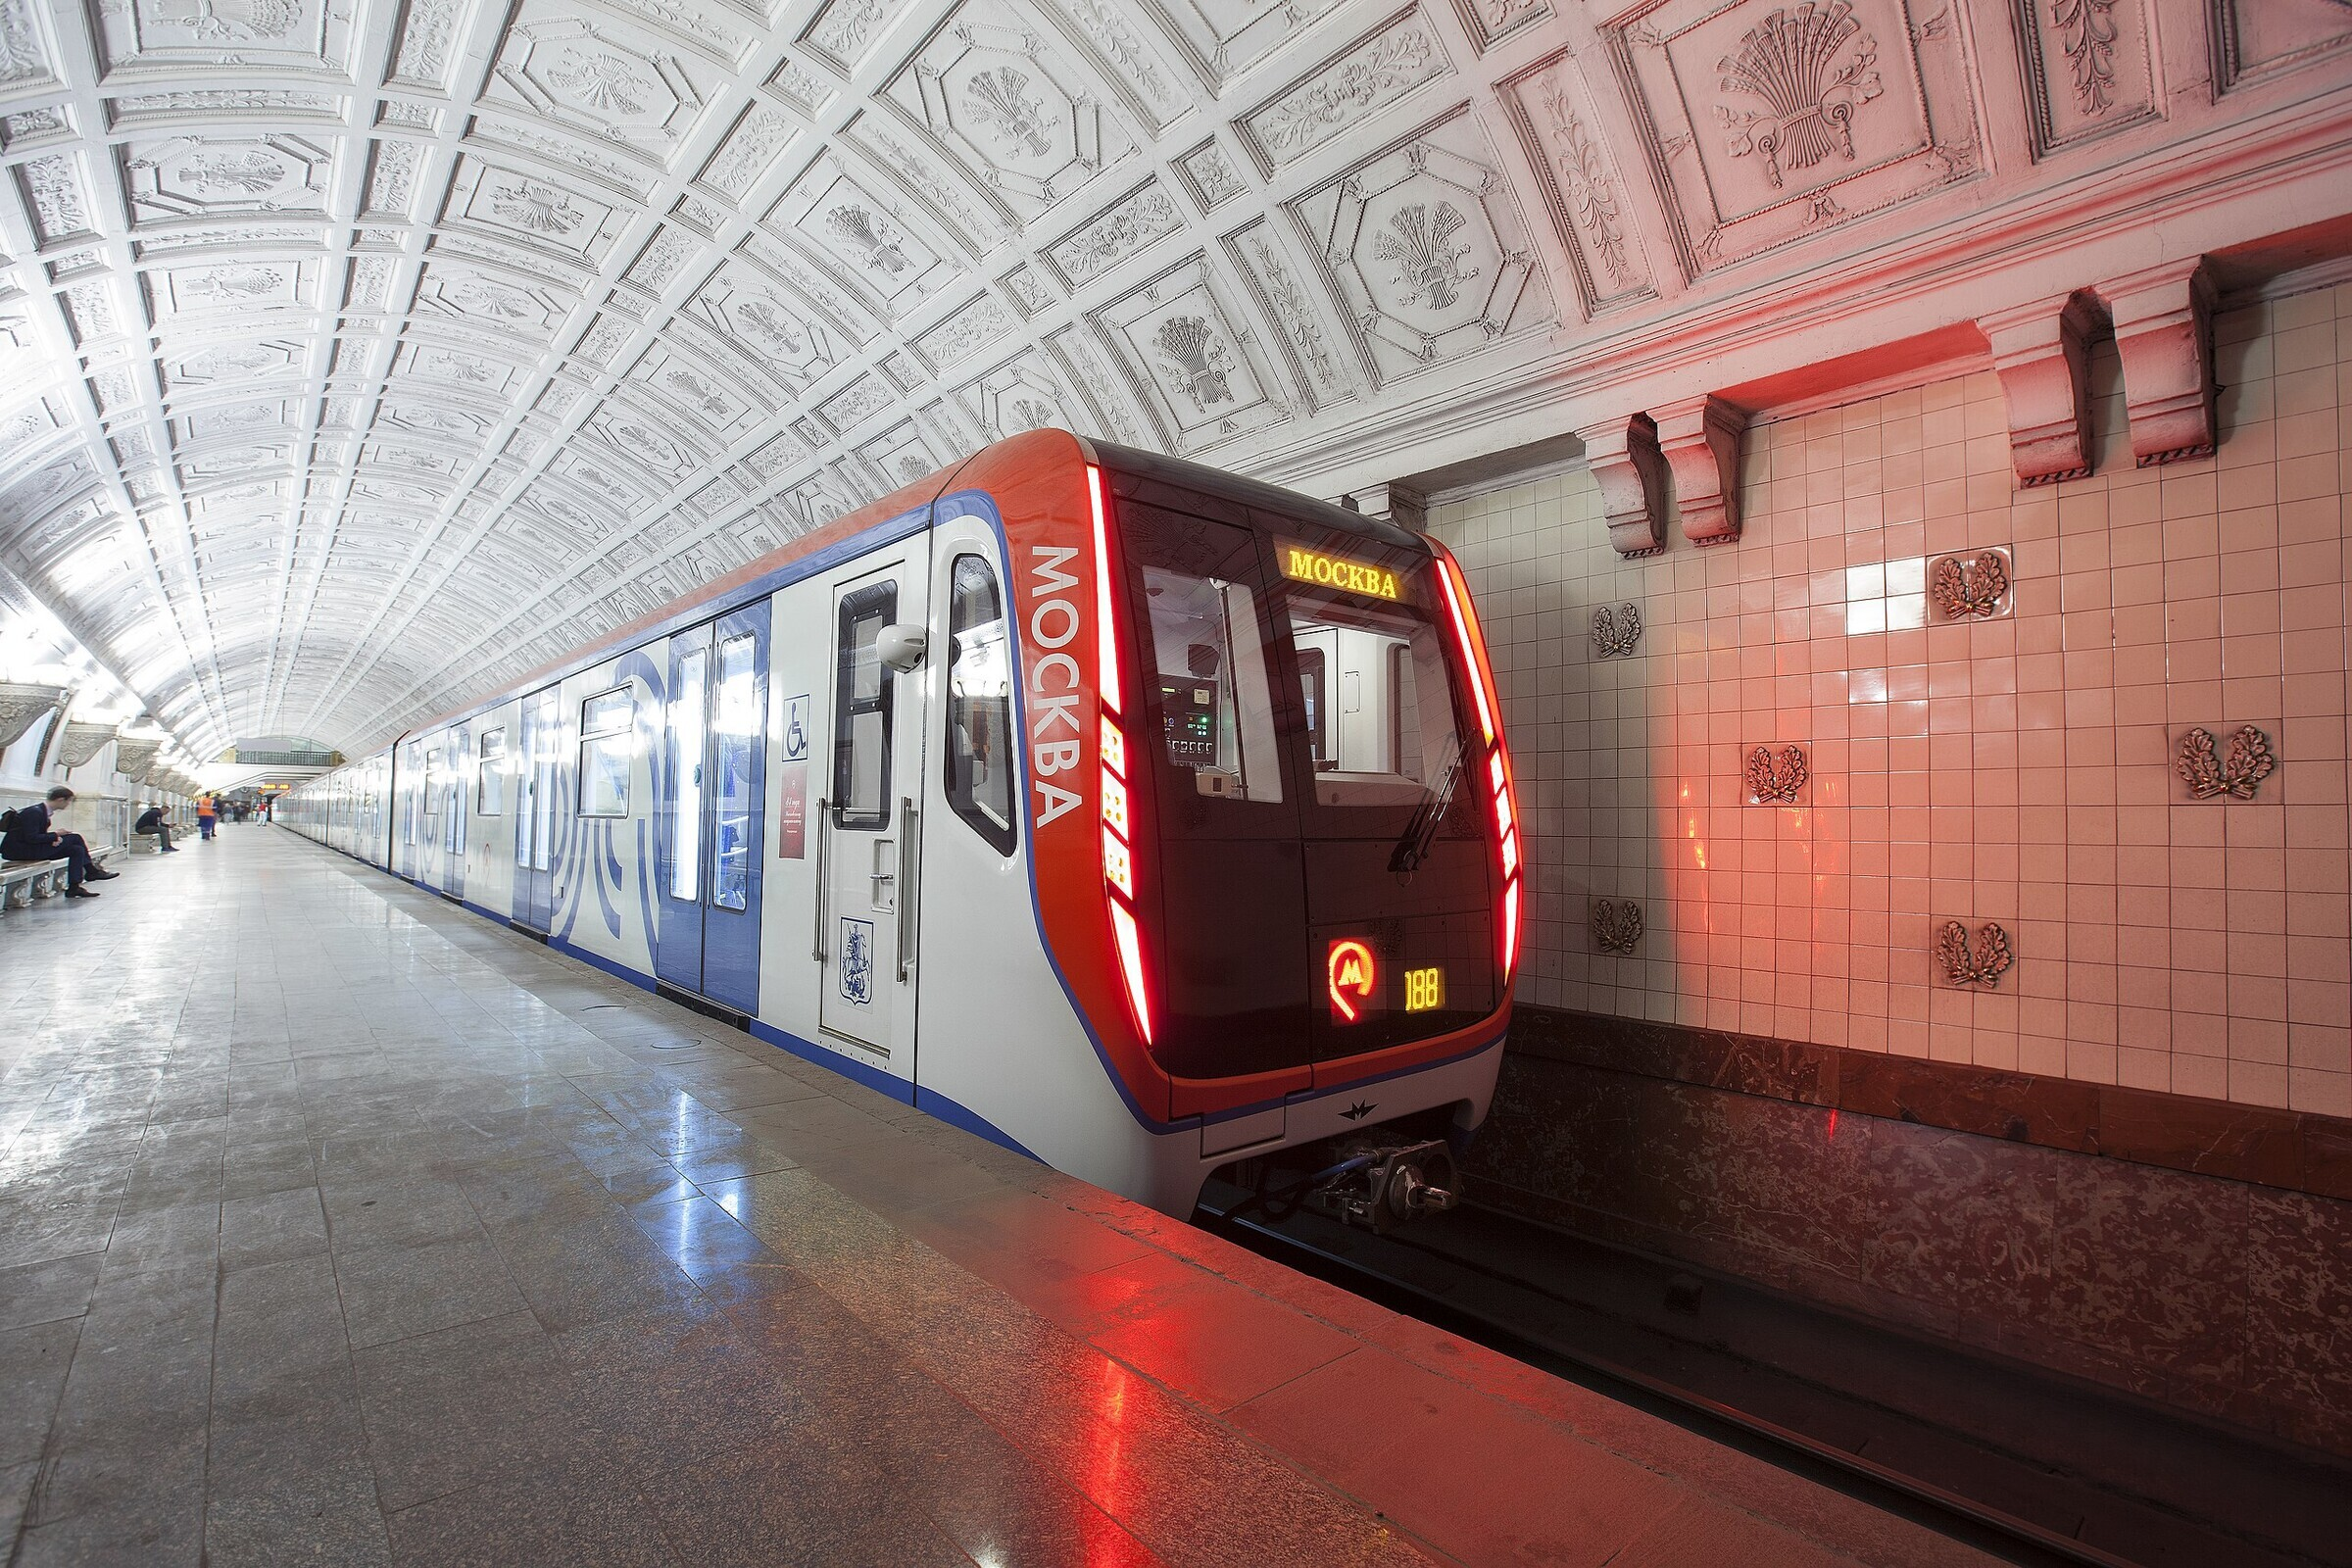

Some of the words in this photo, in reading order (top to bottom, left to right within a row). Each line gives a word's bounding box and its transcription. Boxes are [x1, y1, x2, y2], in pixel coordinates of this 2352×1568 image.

[1288, 550, 1397, 599] МОСКВА
[1031, 546, 1083, 829] МОСКВА
[1404, 967, 1440, 1011] 188
